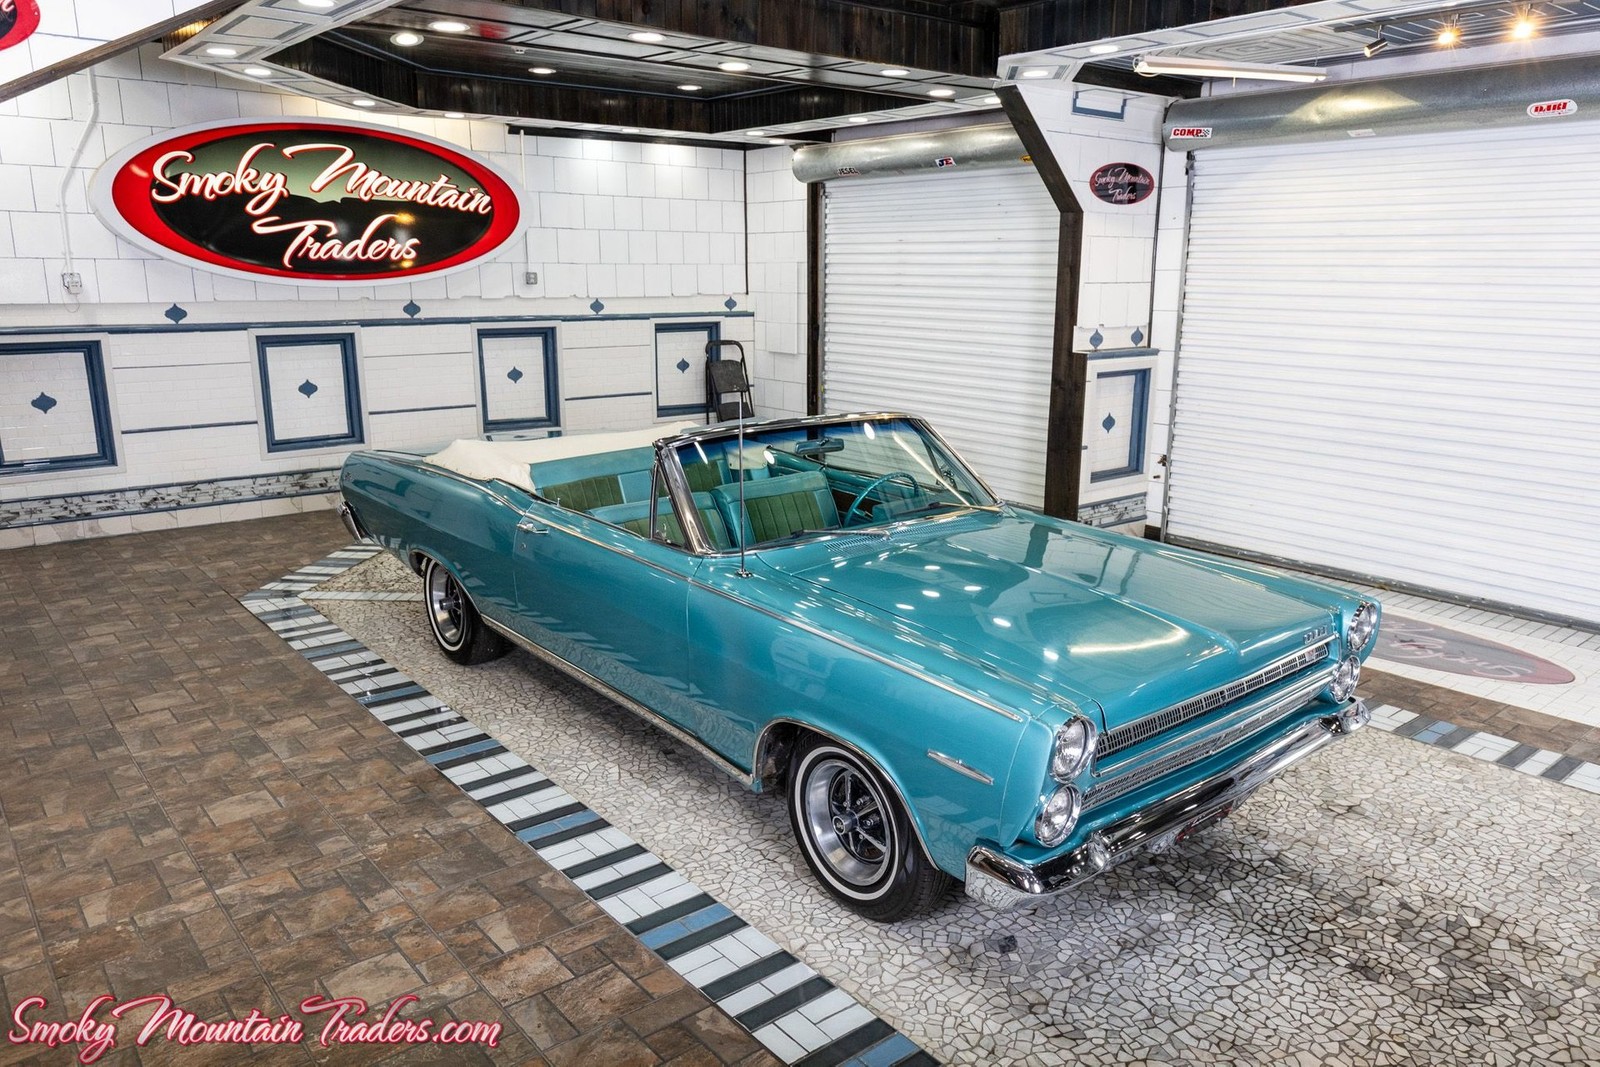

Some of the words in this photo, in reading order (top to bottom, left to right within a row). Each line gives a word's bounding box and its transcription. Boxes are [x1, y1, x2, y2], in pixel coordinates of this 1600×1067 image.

[1173, 128, 1202, 136] COMP
[938, 158, 953, 166] JE
[152, 143, 287, 215] Smoky
[282, 143, 492, 214] Mountain
[1095, 168, 1116, 188] Smoky
[1109, 186, 1136, 203] Traders
[252, 214, 421, 268] Traders
